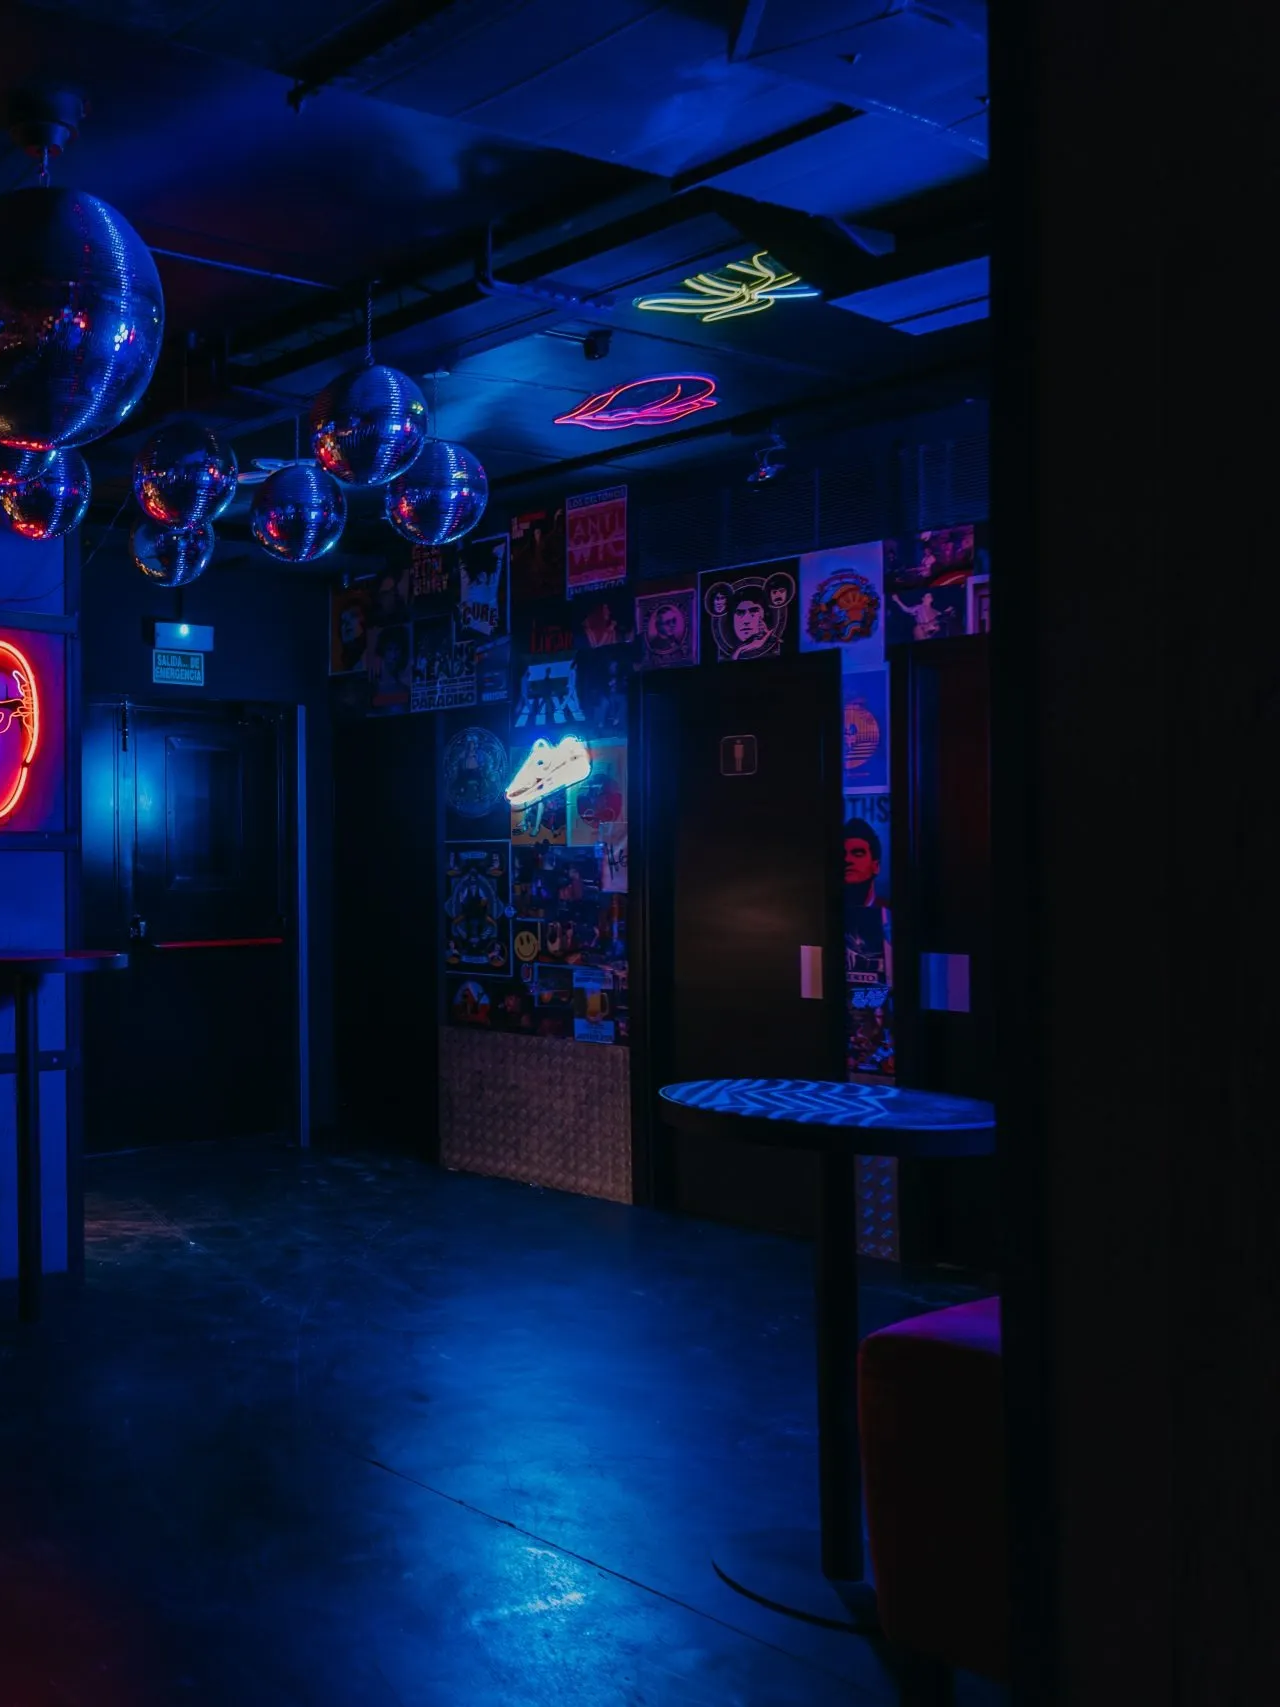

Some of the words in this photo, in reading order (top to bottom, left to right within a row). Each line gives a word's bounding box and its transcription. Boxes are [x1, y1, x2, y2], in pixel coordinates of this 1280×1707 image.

[157, 654, 182, 667] SALIDA
[190, 656, 199, 669] DE
[156, 667, 201, 680] EMERGENCIA
